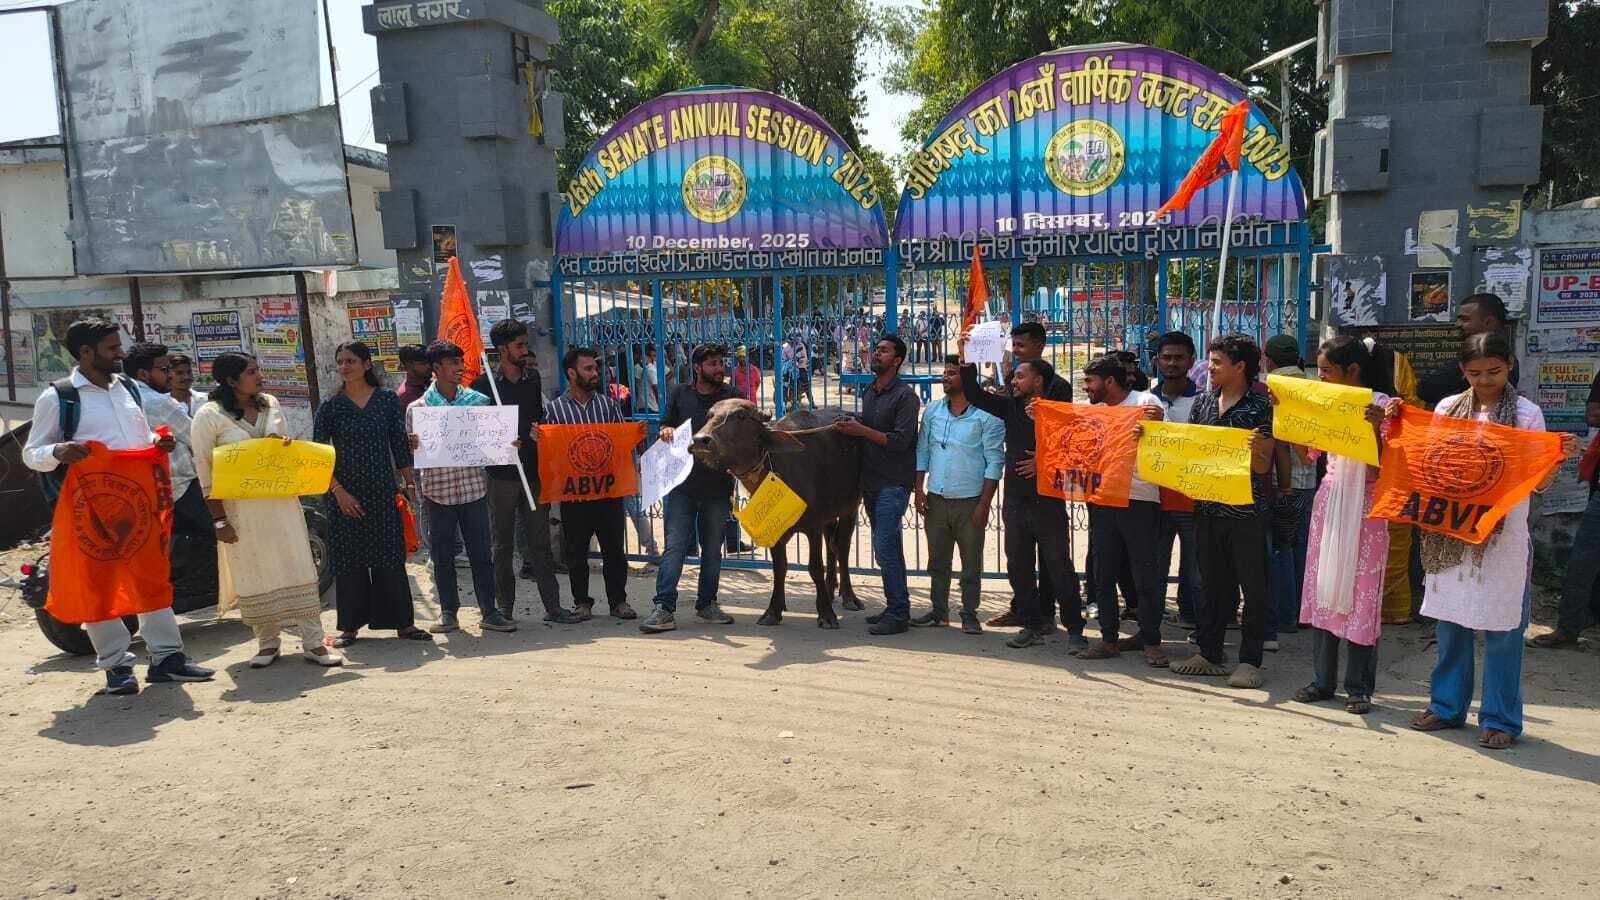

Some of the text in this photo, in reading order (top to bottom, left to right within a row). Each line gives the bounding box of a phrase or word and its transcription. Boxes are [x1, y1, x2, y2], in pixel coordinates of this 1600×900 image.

[377, 4, 418, 29] लालू
[969, 95, 1009, 136] का
[1059, 55, 1137, 105] वार्षिक
[1138, 71, 1200, 117] बजट
[566, 166, 605, 218] 26th
[597, 114, 669, 180] SENATE
[669, 101, 741, 144] ANNUAL
[745, 104, 829, 167] SESSION
[832, 150, 880, 210] 2025
[996, 217, 1018, 232] 10
[1023, 211, 1110, 231] दिसम्बर,
[625, 233, 810, 251] 10 December, 2025
[1021, 233, 1080, 267] कुमार
[1083, 230, 1139, 258] यादव
[1542, 365, 1577, 375] RESULT
[1555, 374, 1590, 384] MAKER
[1147, 428, 1192, 451] महिला
[563, 473, 615, 496] ABVP
